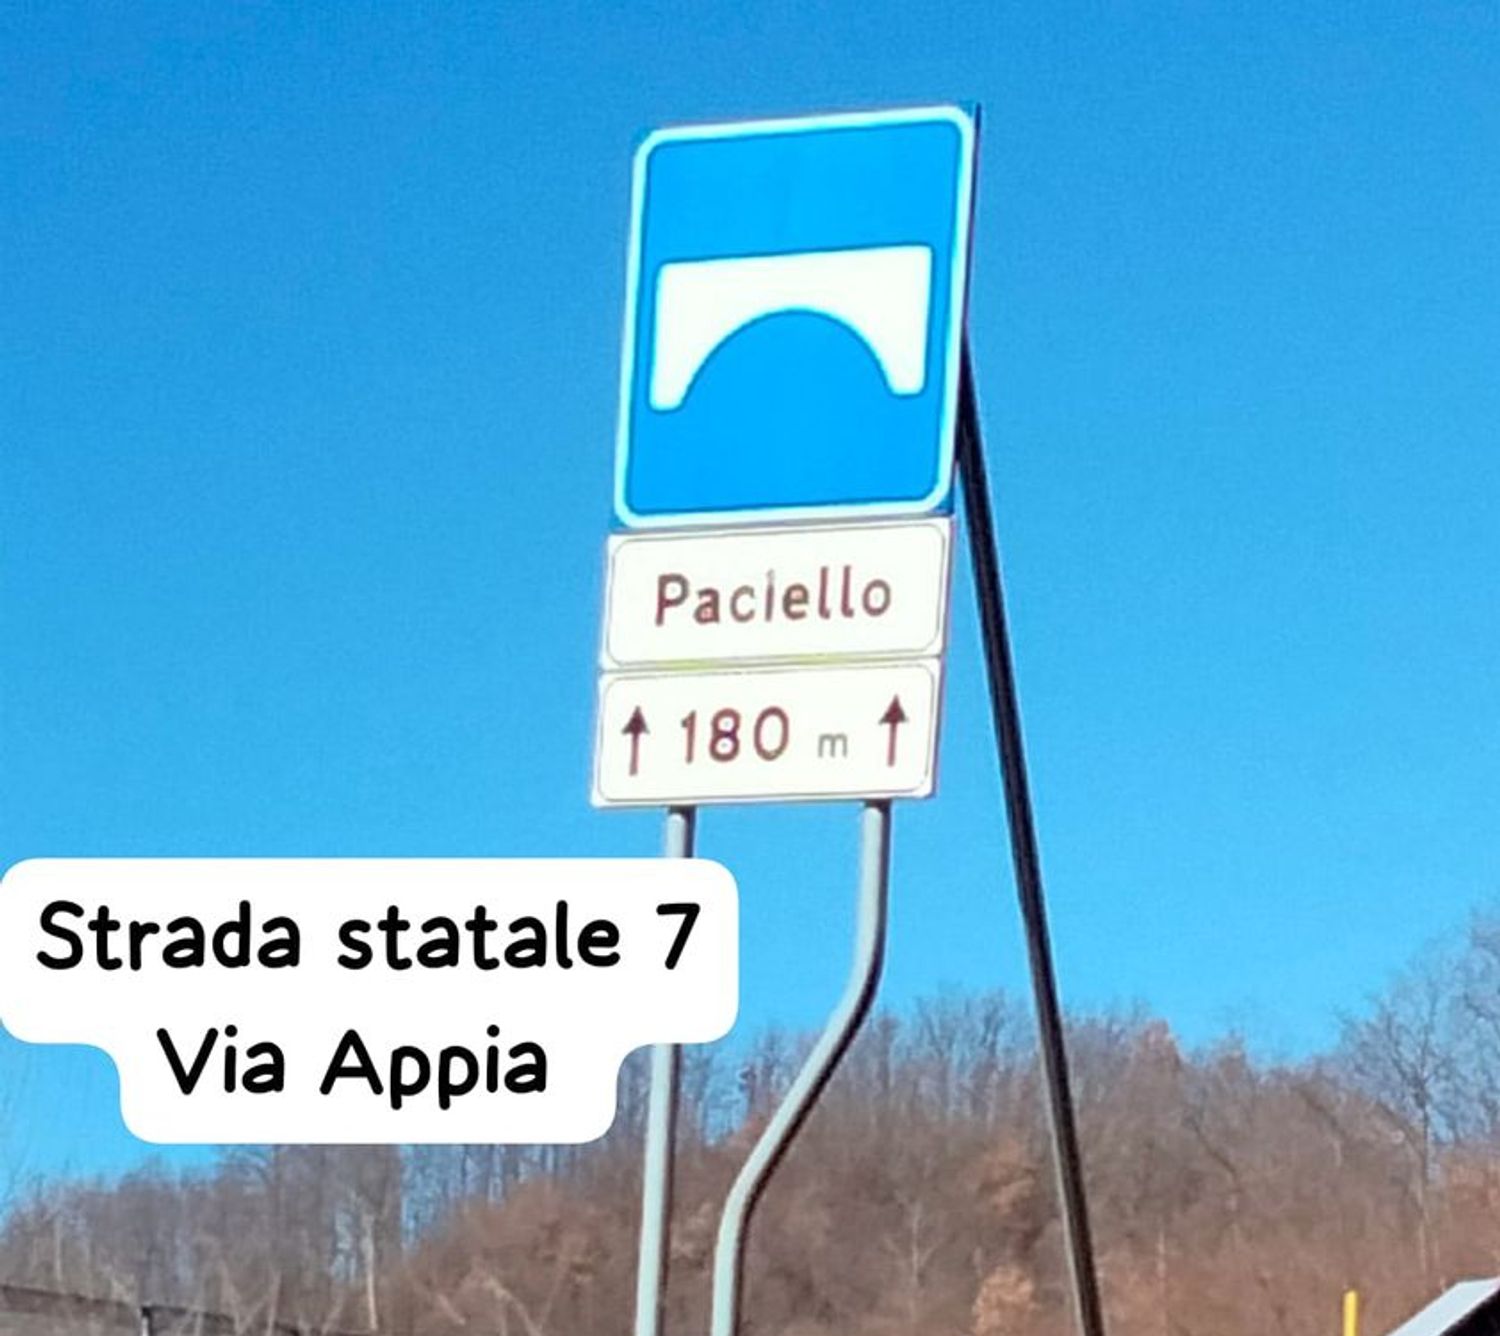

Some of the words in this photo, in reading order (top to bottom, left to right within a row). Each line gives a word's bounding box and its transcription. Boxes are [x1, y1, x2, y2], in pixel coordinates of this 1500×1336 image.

[655, 565, 892, 627] Paciello
[680, 706, 790, 764] 180
[816, 731, 849, 758] m
